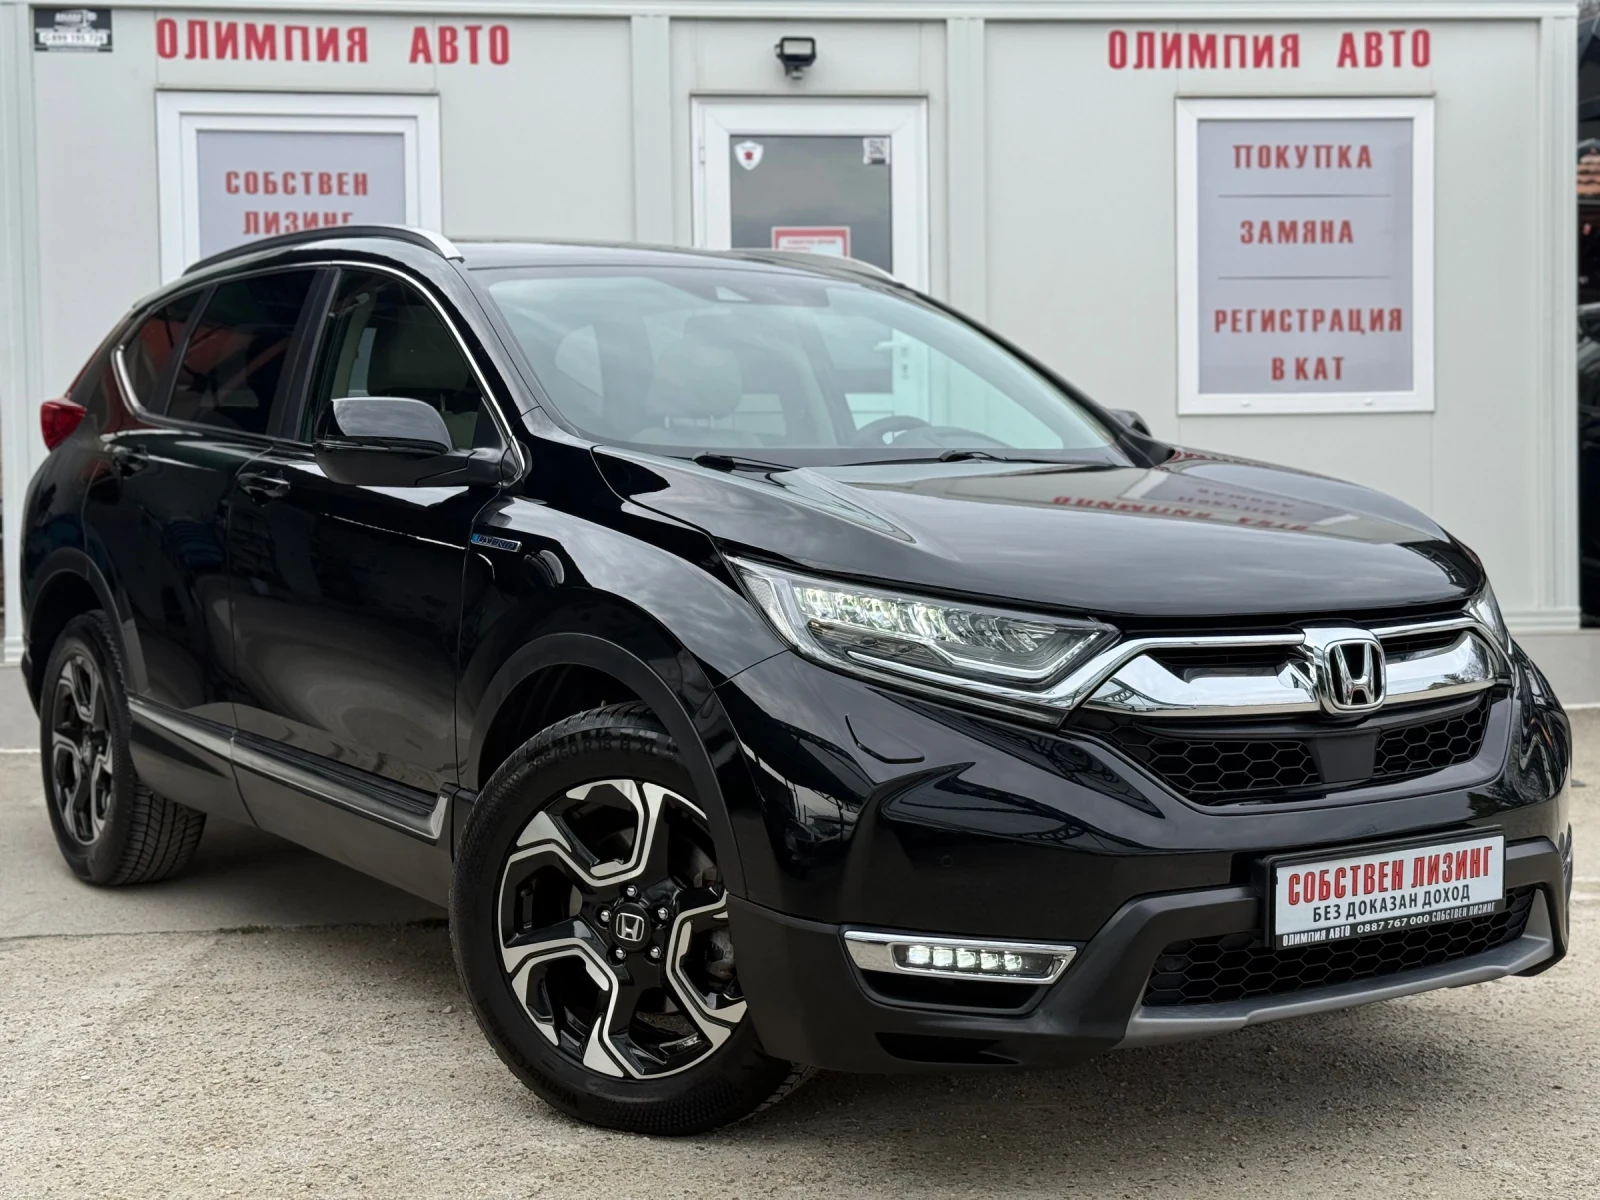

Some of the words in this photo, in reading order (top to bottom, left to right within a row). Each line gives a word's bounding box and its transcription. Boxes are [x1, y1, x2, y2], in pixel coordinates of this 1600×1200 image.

[156, 18, 368, 63] ОЛИМПИЯ
[409, 25, 509, 65] АВТО
[1108, 30, 1299, 69] ОЛИМПИЯ
[1337, 29, 1430, 68] АВТО
[1233, 145, 1372, 168] ПОКУПКА
[225, 170, 368, 196] СОБСТВЕН
[1240, 220, 1354, 244] ЗАМЯНА
[1215, 308, 1403, 334] РЕГИСТРАЦИЯ
[1271, 357, 1285, 381] В
[1295, 356, 1344, 380] КАТ
[1288, 859, 1404, 906] СОБСТВЕН
[1411, 846, 1493, 888] ЛИЗИНГ
[1312, 904, 1341, 922] БЕЗ
[1346, 894, 1418, 921] ДОКАЗАН
[1422, 884, 1470, 908] ДОХОД
[1282, 929, 1326, 947] ОЛИМПИЯ
[1329, 925, 1350, 940] АВТО
[1357, 921, 1385, 934] 0887
[1387, 917, 1408, 929] 767
[1410, 914, 1430, 925] 000
[1432, 907, 1467, 922] СОБСТВЕН
[1469, 902, 1496, 917] ЛИЗИНГ
